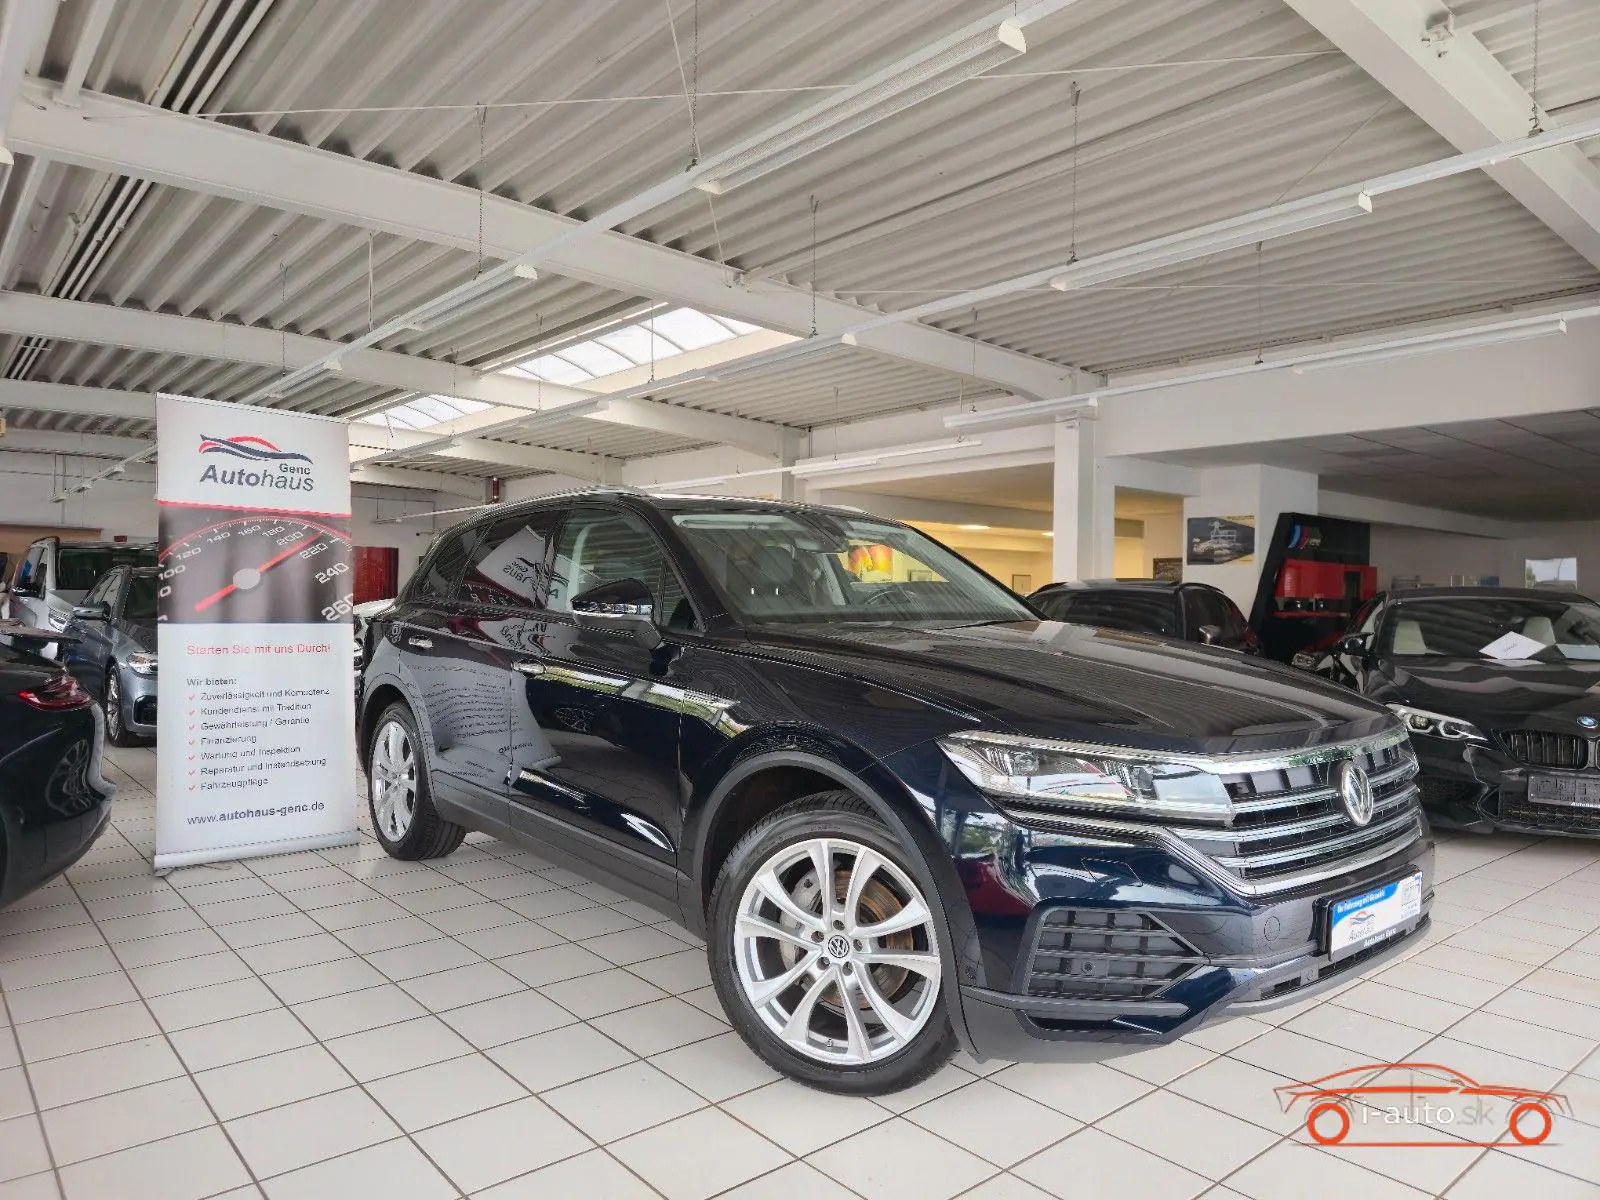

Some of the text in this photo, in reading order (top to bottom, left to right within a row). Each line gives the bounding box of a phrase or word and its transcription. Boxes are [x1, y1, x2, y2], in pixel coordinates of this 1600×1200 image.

[279, 463, 311, 475] Genc
[200, 465, 314, 491] Autohaus
[207, 531, 231, 544] 140
[276, 531, 304, 546] 200
[176, 547, 202, 560] 120
[299, 542, 328, 559] 220
[158, 564, 186, 580] 100
[315, 562, 350, 584] 240
[187, 645, 229, 655] Starten
[232, 645, 250, 654] Sie
[254, 645, 271, 654] mit
[274, 645, 293, 654] uns
[186, 678, 203, 686] Wir
[187, 801, 325, 826] www.autohaus-genc.de
